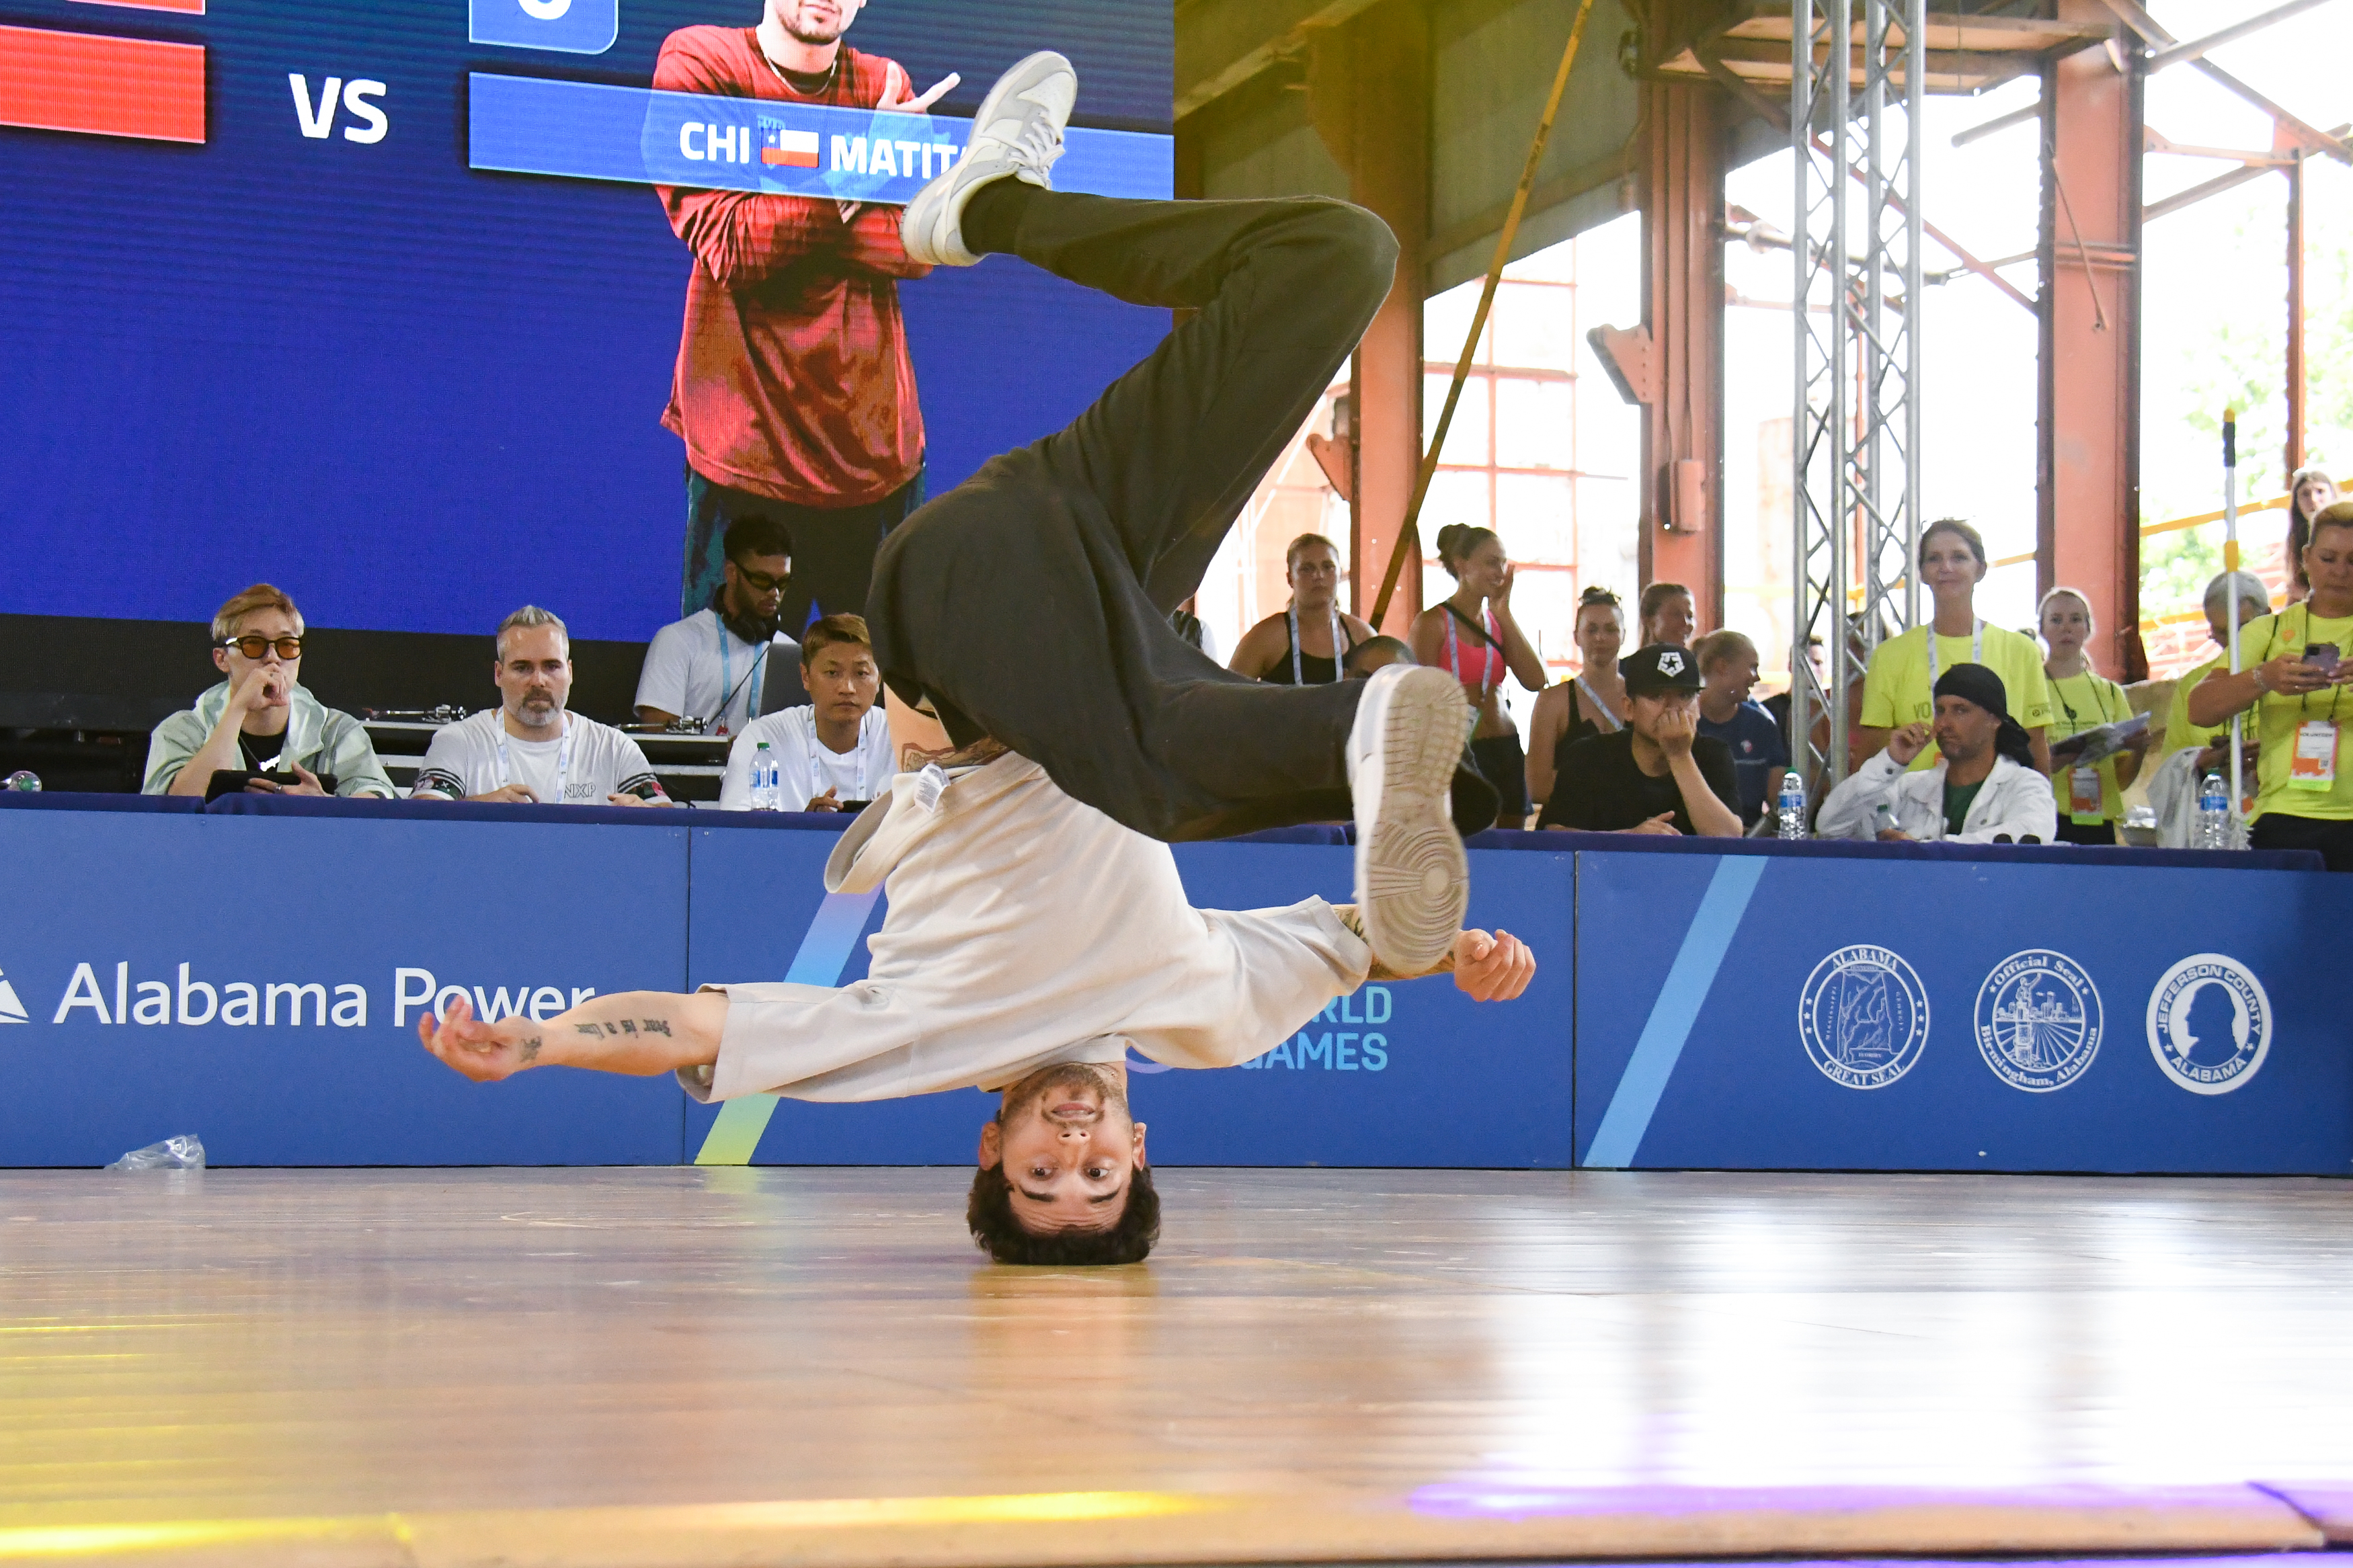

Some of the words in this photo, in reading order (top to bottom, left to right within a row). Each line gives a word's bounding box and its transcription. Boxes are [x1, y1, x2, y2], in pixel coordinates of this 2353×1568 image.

[289, 73, 388, 144] VS
[680, 122, 750, 164] CHI
[830, 134, 967, 179] MATIT
[1832, 948, 1898, 971] ALABAMA
[1994, 956, 2048, 986] Official
[2054, 960, 2085, 988] Seal
[53, 961, 367, 1027] Alabama
[394, 968, 596, 1027] Power
[2157, 965, 2223, 1034] JEFFERSON
[2223, 969, 2261, 1036] COUNTY
[1240, 1032, 1388, 1071] AMES
[1824, 1060, 1868, 1086] GREAT
[1872, 1063, 1905, 1085] SEAL
[1981, 1024, 2055, 1086] Birmingham,
[2056, 1027, 2098, 1082] Alabama
[2170, 1056, 2247, 1082] ALABAMA
